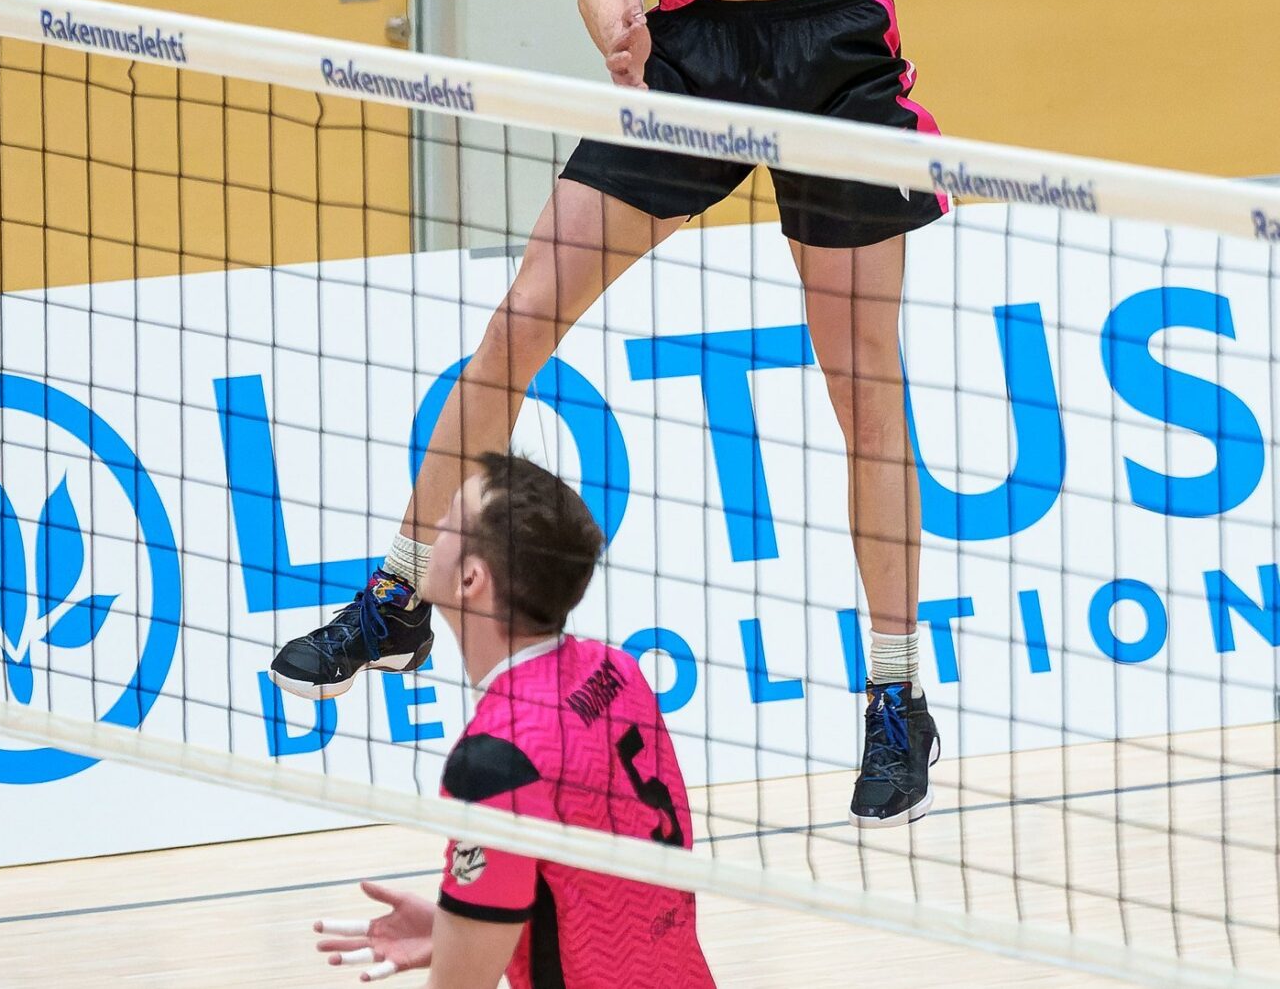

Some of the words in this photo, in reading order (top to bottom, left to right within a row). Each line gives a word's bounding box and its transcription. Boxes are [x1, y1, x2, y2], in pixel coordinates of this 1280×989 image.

[40, 10, 187, 64] Rakennuslehti
[320, 57, 475, 112] Rakennuslehti
[620, 108, 780, 164] Rakennuslehti
[929, 160, 1097, 213] Rakennuslehti
[213, 286, 1266, 614] LOTUS
[257, 562, 1280, 758] DEOLITION
[615, 723, 685, 849] 5
